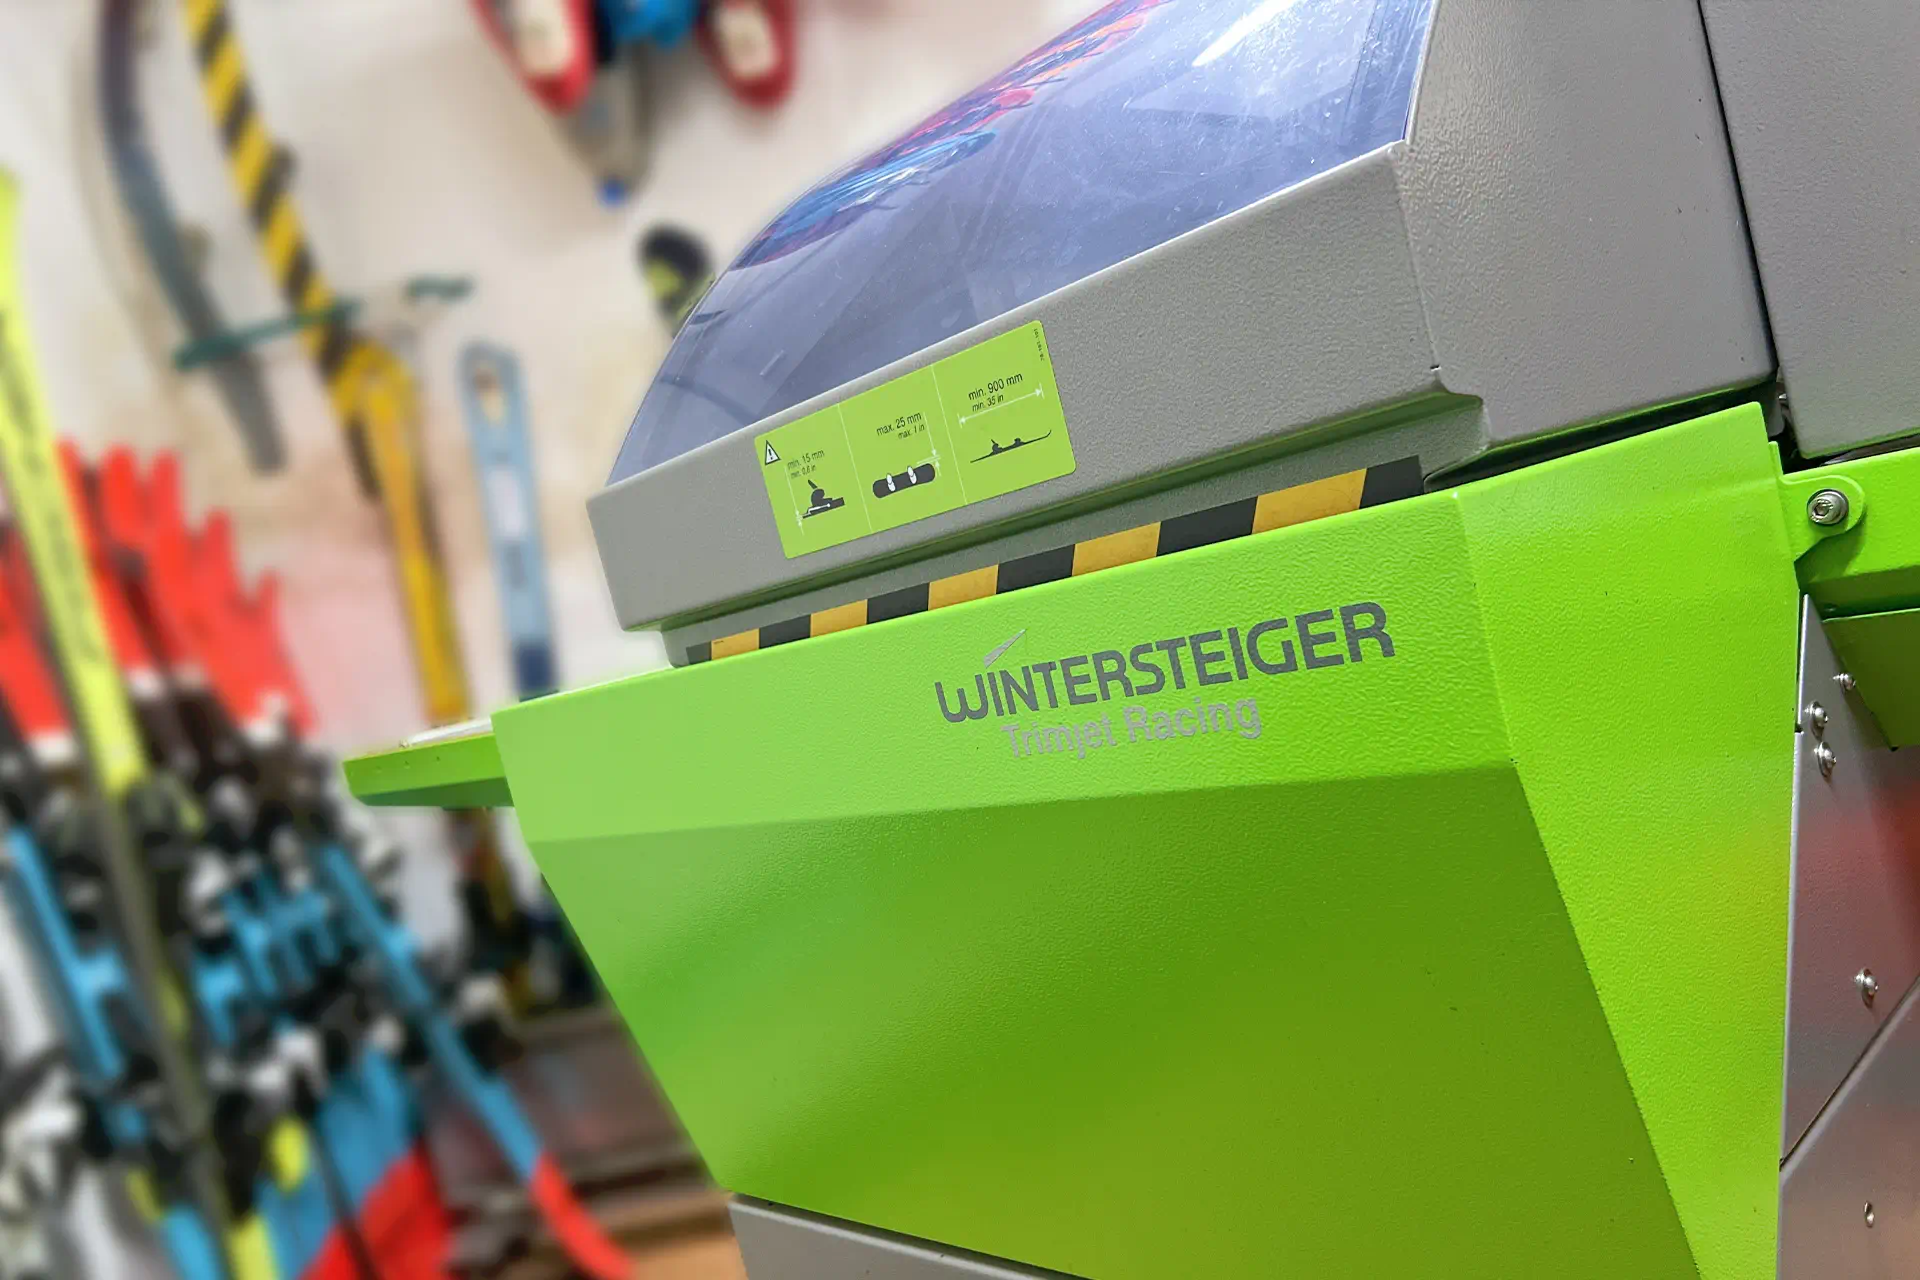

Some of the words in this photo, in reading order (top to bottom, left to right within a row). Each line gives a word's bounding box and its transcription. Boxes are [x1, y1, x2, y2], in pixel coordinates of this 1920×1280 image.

[968, 387, 986, 401] min.
[987, 378, 1005, 393] 900
[1006, 373, 1023, 386] mm
[987, 395, 996, 407] 35
[997, 393, 1004, 403] in
[876, 424, 894, 436] max.
[895, 416, 906, 429] 25
[906, 412, 922, 425] mm
[787, 459, 801, 471] min.
[802, 452, 811, 463] 15
[811, 449, 825, 460] mm
[934, 601, 1396, 723] WINTERSTEIGER
[1001, 713, 1117, 759] Trimjet
[1123, 696, 1262, 739] Racing
